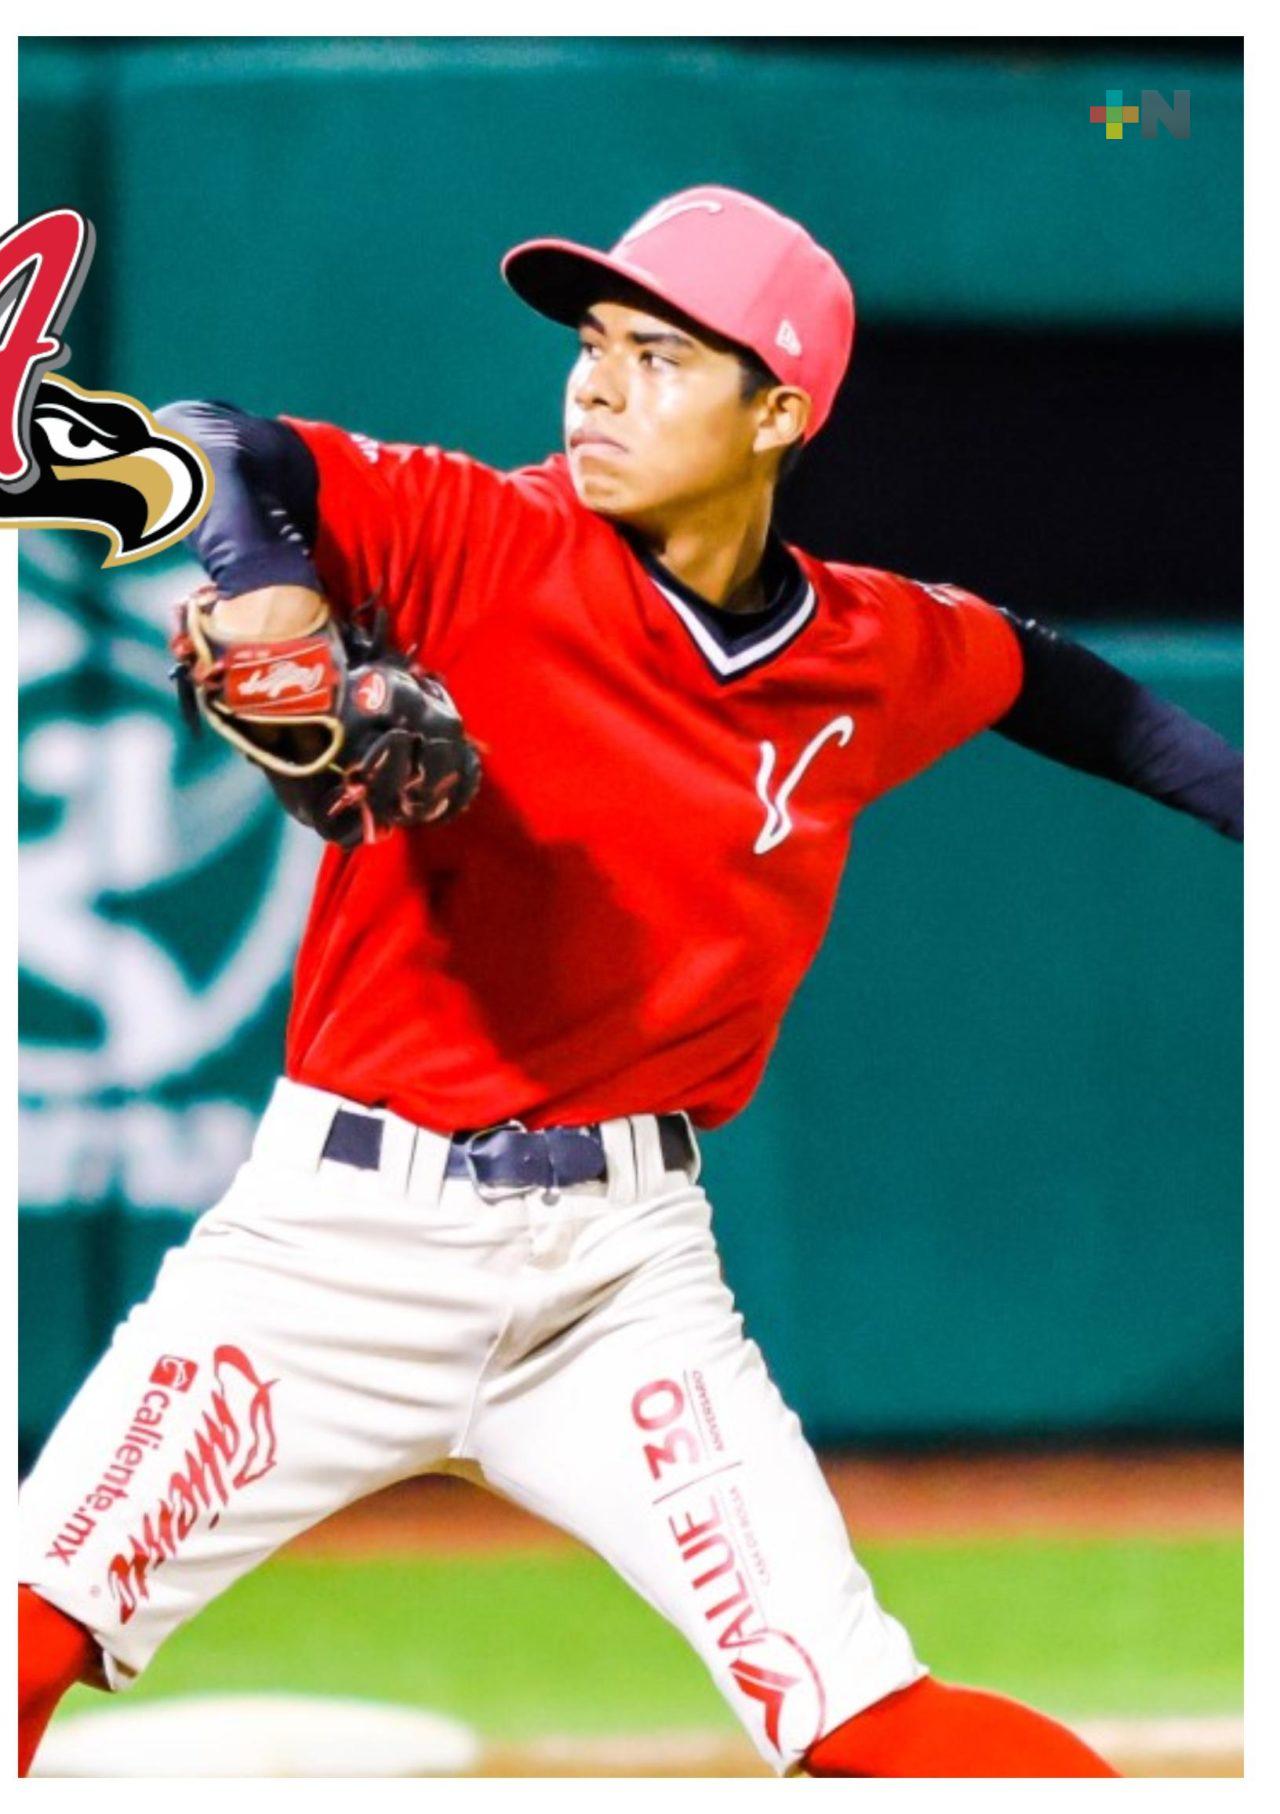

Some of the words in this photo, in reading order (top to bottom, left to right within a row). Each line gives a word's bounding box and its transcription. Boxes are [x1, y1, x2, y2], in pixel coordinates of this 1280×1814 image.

[753, 714, 854, 856] V
[45, 1389, 171, 1566] caliente.mx
[107, 1344, 280, 1625] Caliente
[631, 1378, 702, 1482] 30
